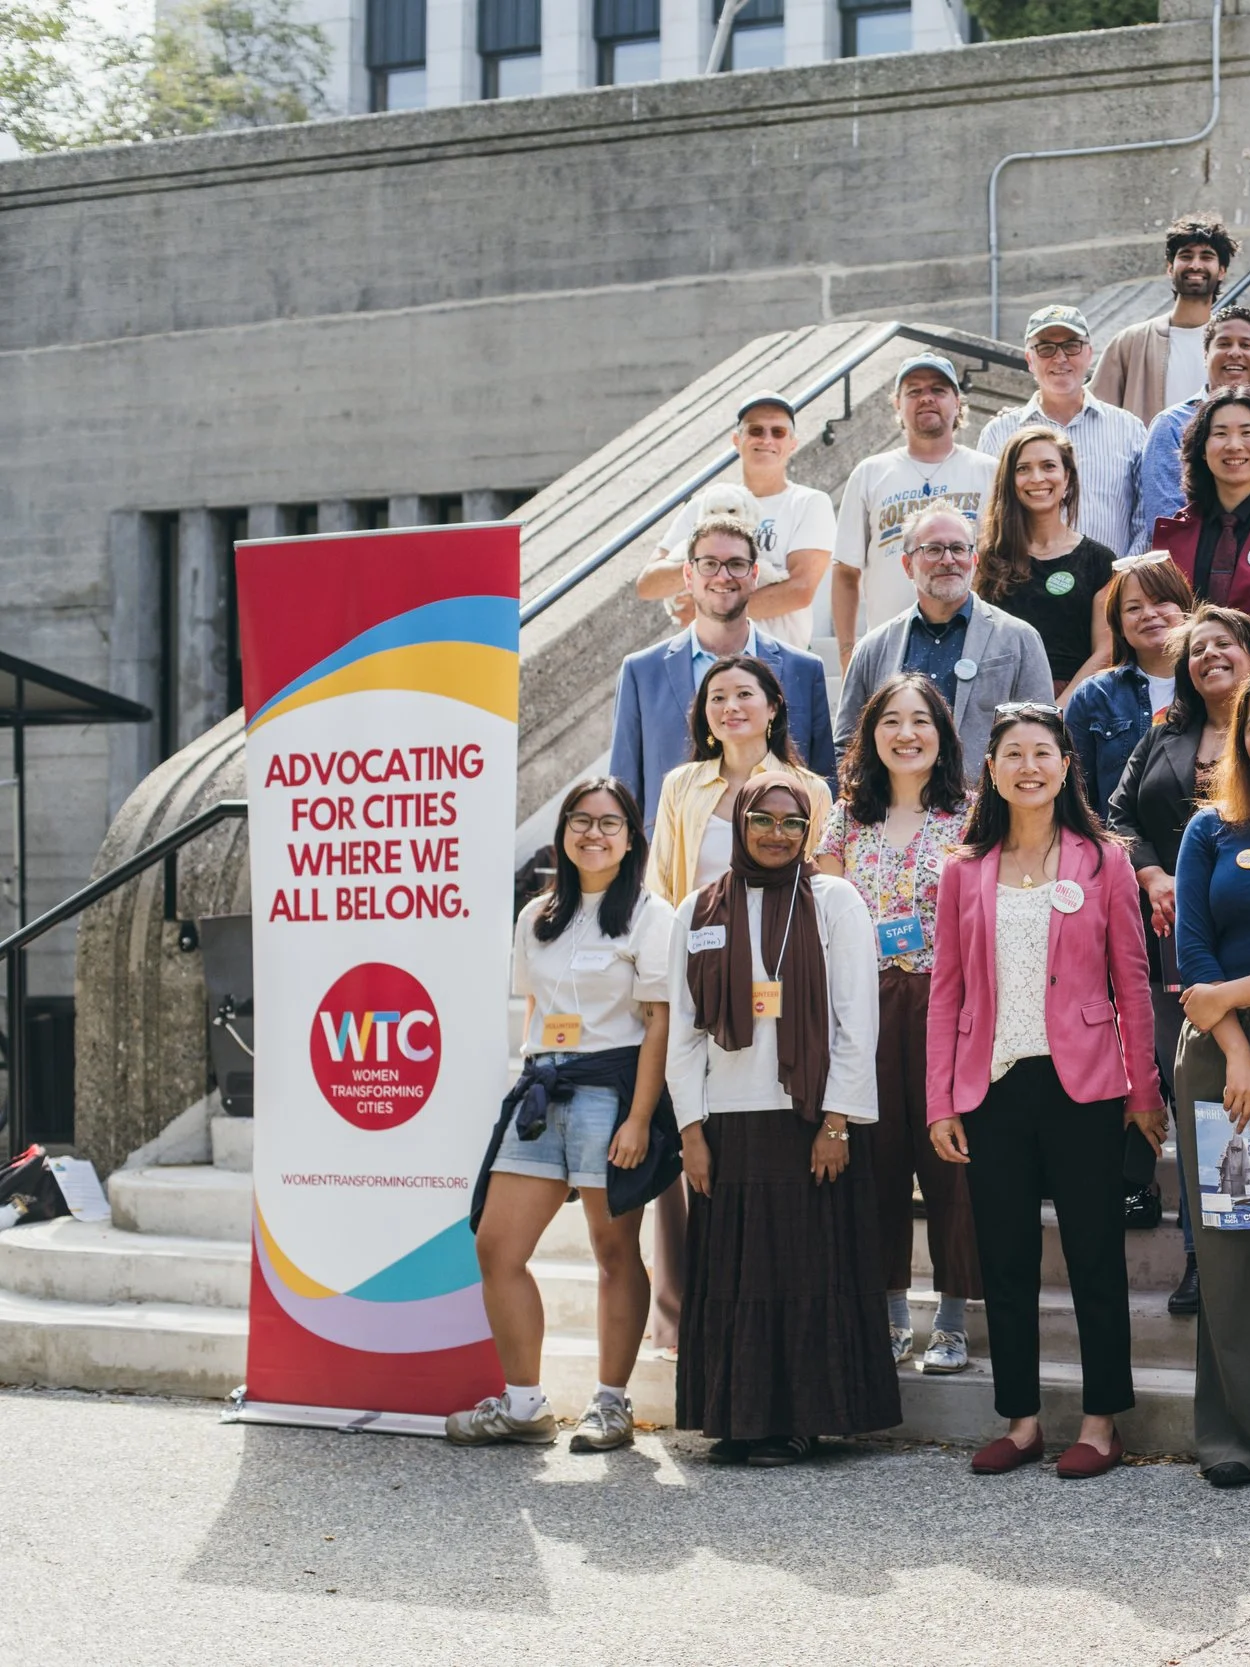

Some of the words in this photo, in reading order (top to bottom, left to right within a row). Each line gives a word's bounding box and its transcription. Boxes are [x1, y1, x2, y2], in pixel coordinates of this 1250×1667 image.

[264, 743, 485, 788] ADVOCATING
[291, 796, 356, 831] FOR
[362, 791, 457, 829] CITIES
[287, 839, 402, 877] WHERE
[410, 837, 459, 873] WE
[269, 888, 328, 923] ALL
[337, 883, 470, 921] BELONG.
[885, 924, 914, 938] STAFF
[319, 1010, 434, 1062] WTC
[352, 1069, 399, 1082] WOMEN
[331, 1084, 424, 1098] TRANSFORMING
[356, 1100, 393, 1114] CITIES
[281, 1173, 469, 1189] WOMENTRANSFORMINGCITIES.ORG
